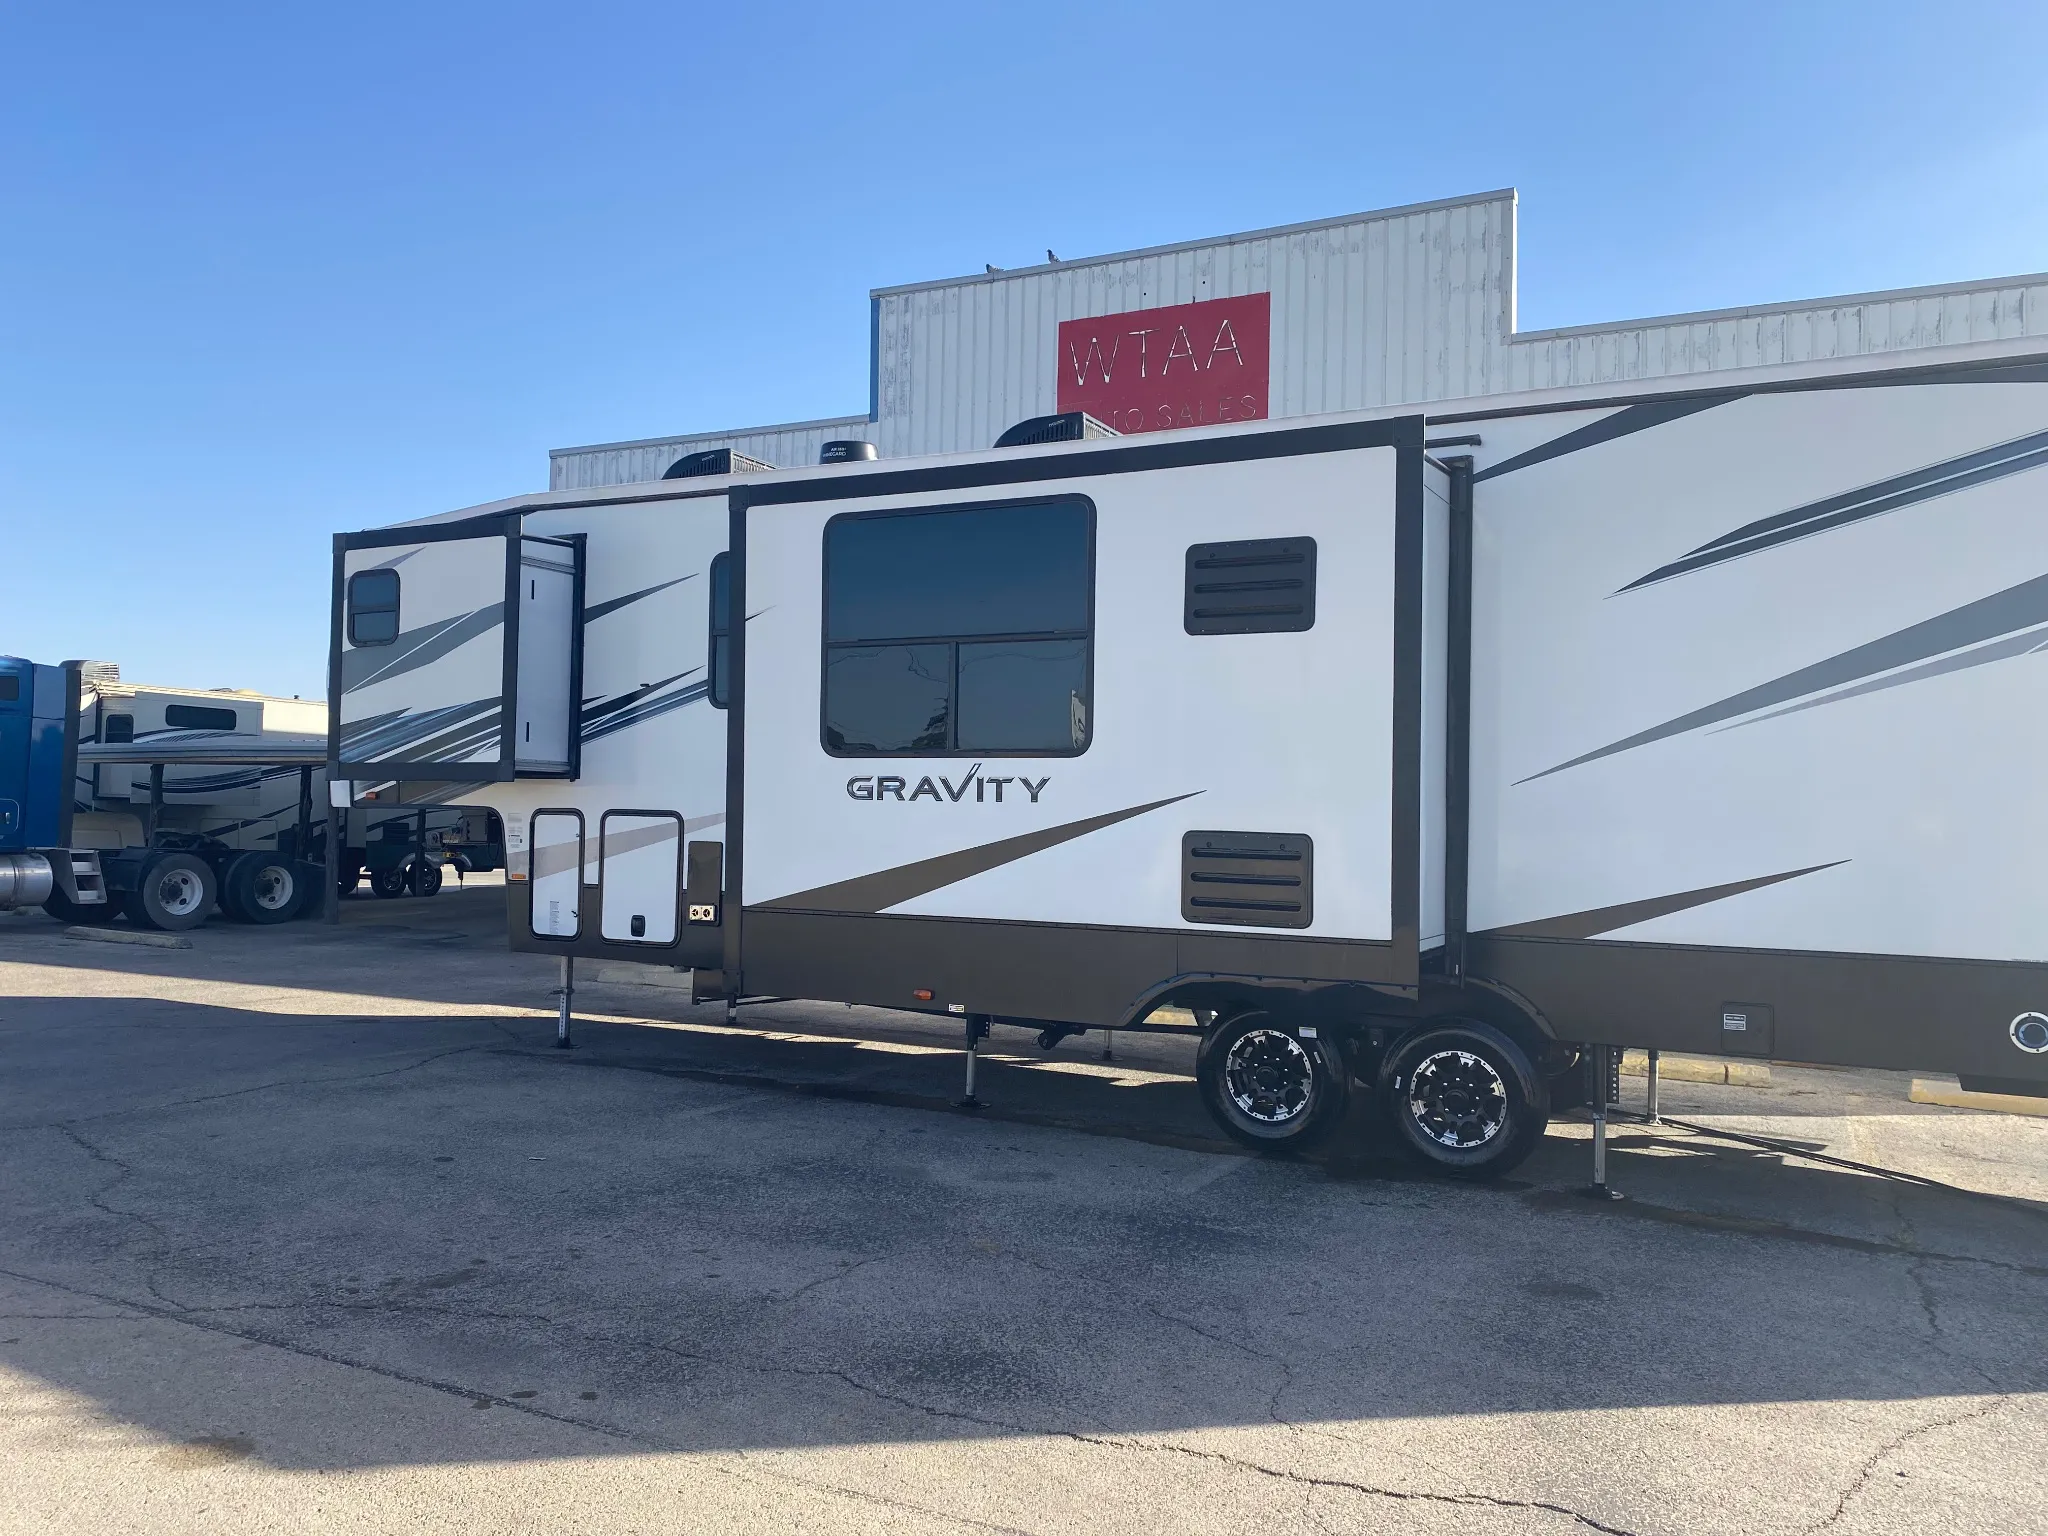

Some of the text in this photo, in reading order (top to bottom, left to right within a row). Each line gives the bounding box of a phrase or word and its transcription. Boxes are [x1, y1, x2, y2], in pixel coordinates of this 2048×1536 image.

[1070, 319, 1244, 386] WTAA
[1156, 395, 1256, 428] SALES
[846, 762, 1052, 804] GRAVITY
